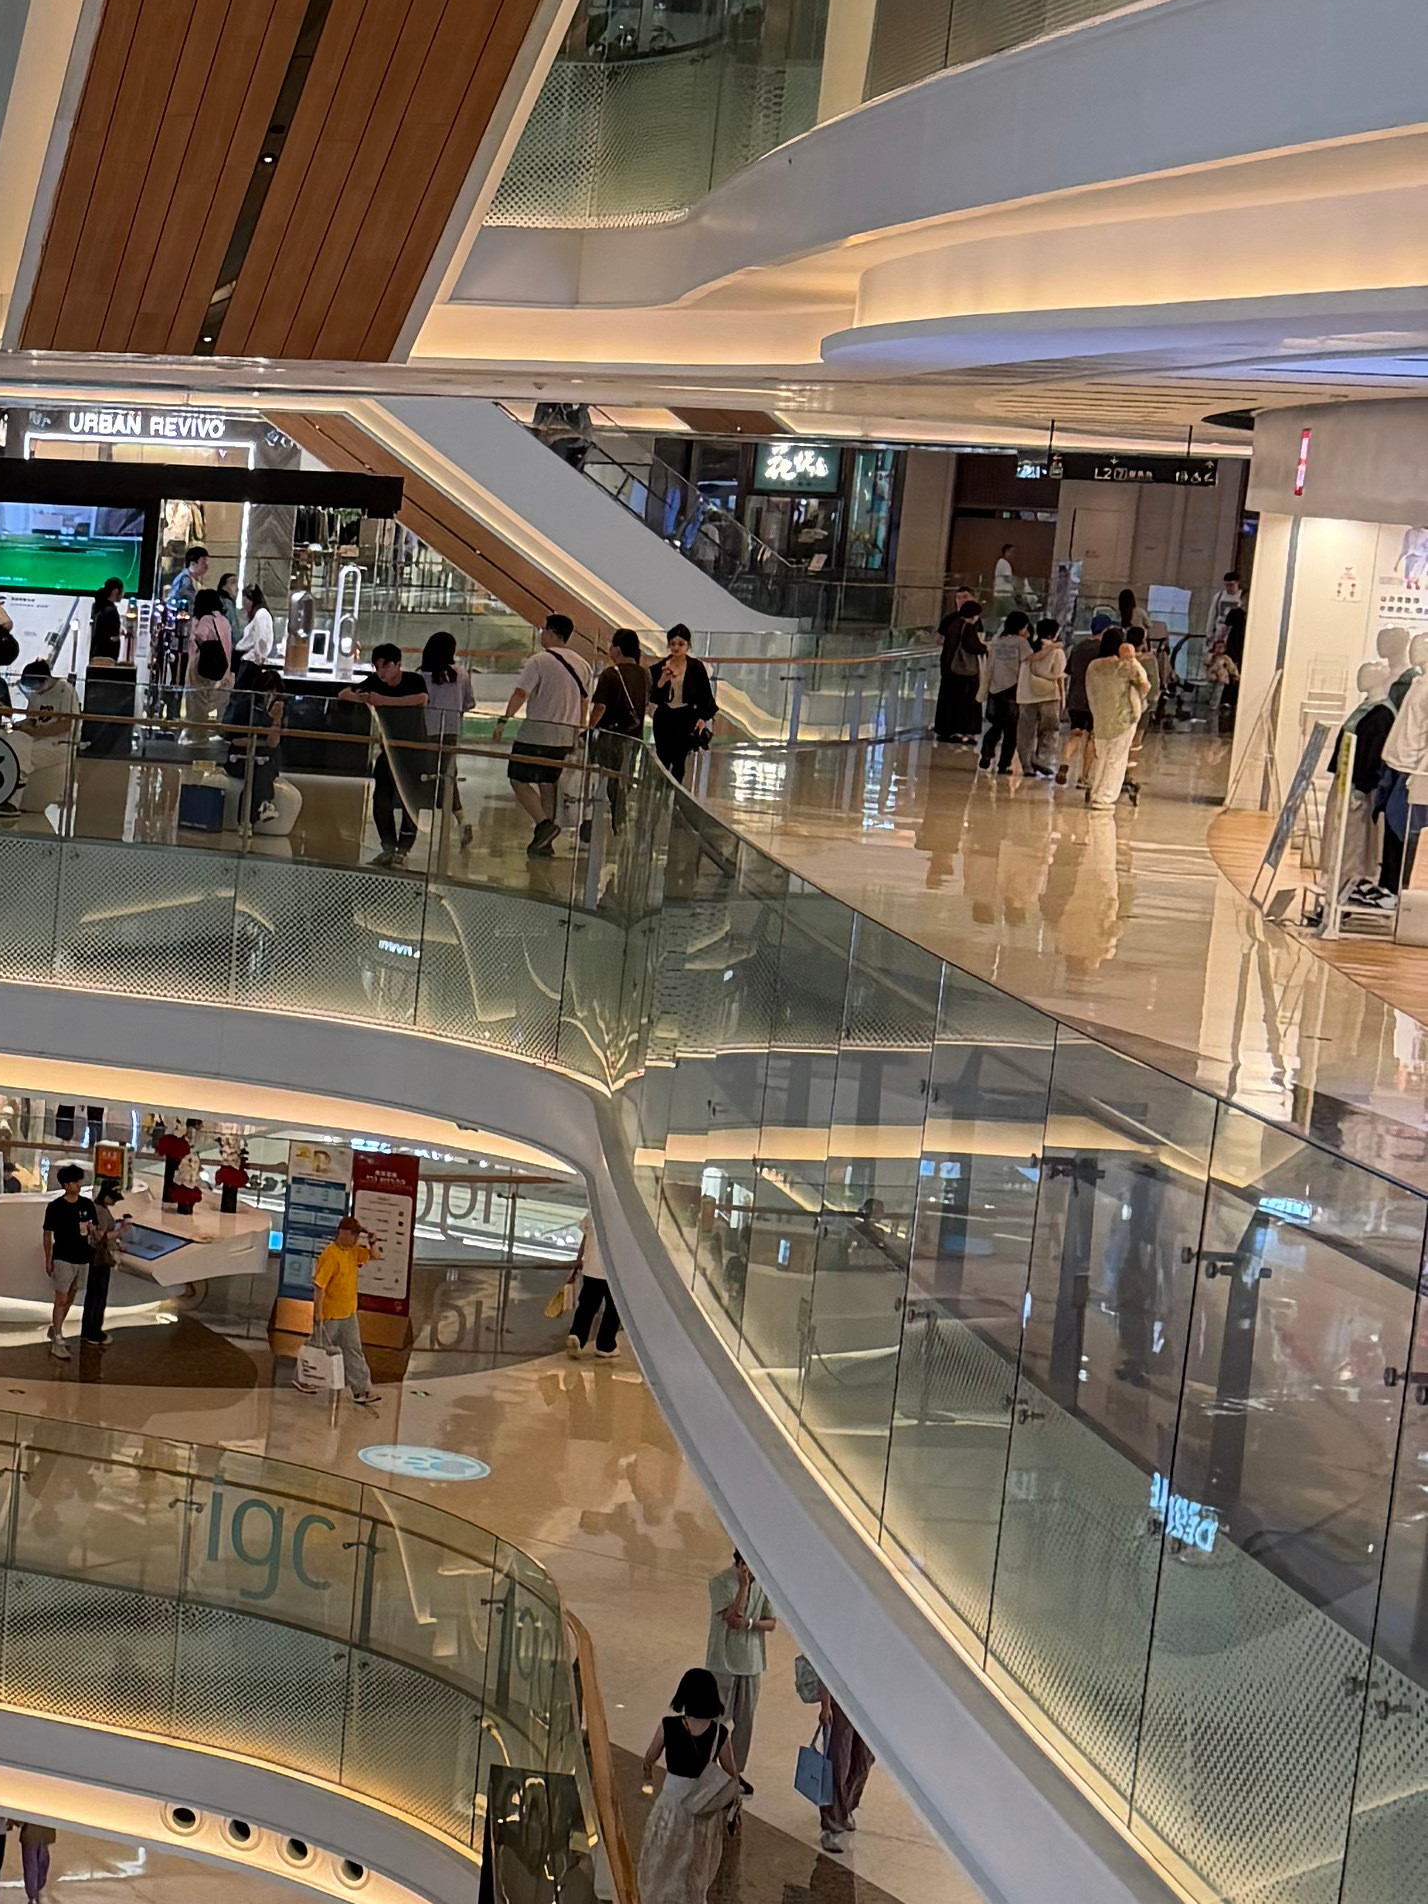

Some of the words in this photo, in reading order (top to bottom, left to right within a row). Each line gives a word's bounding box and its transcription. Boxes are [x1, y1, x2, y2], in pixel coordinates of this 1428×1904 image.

[69, 411, 142, 435] URBAN
[150, 415, 226, 438] REVIVO
[206, 1473, 337, 1601] igc
